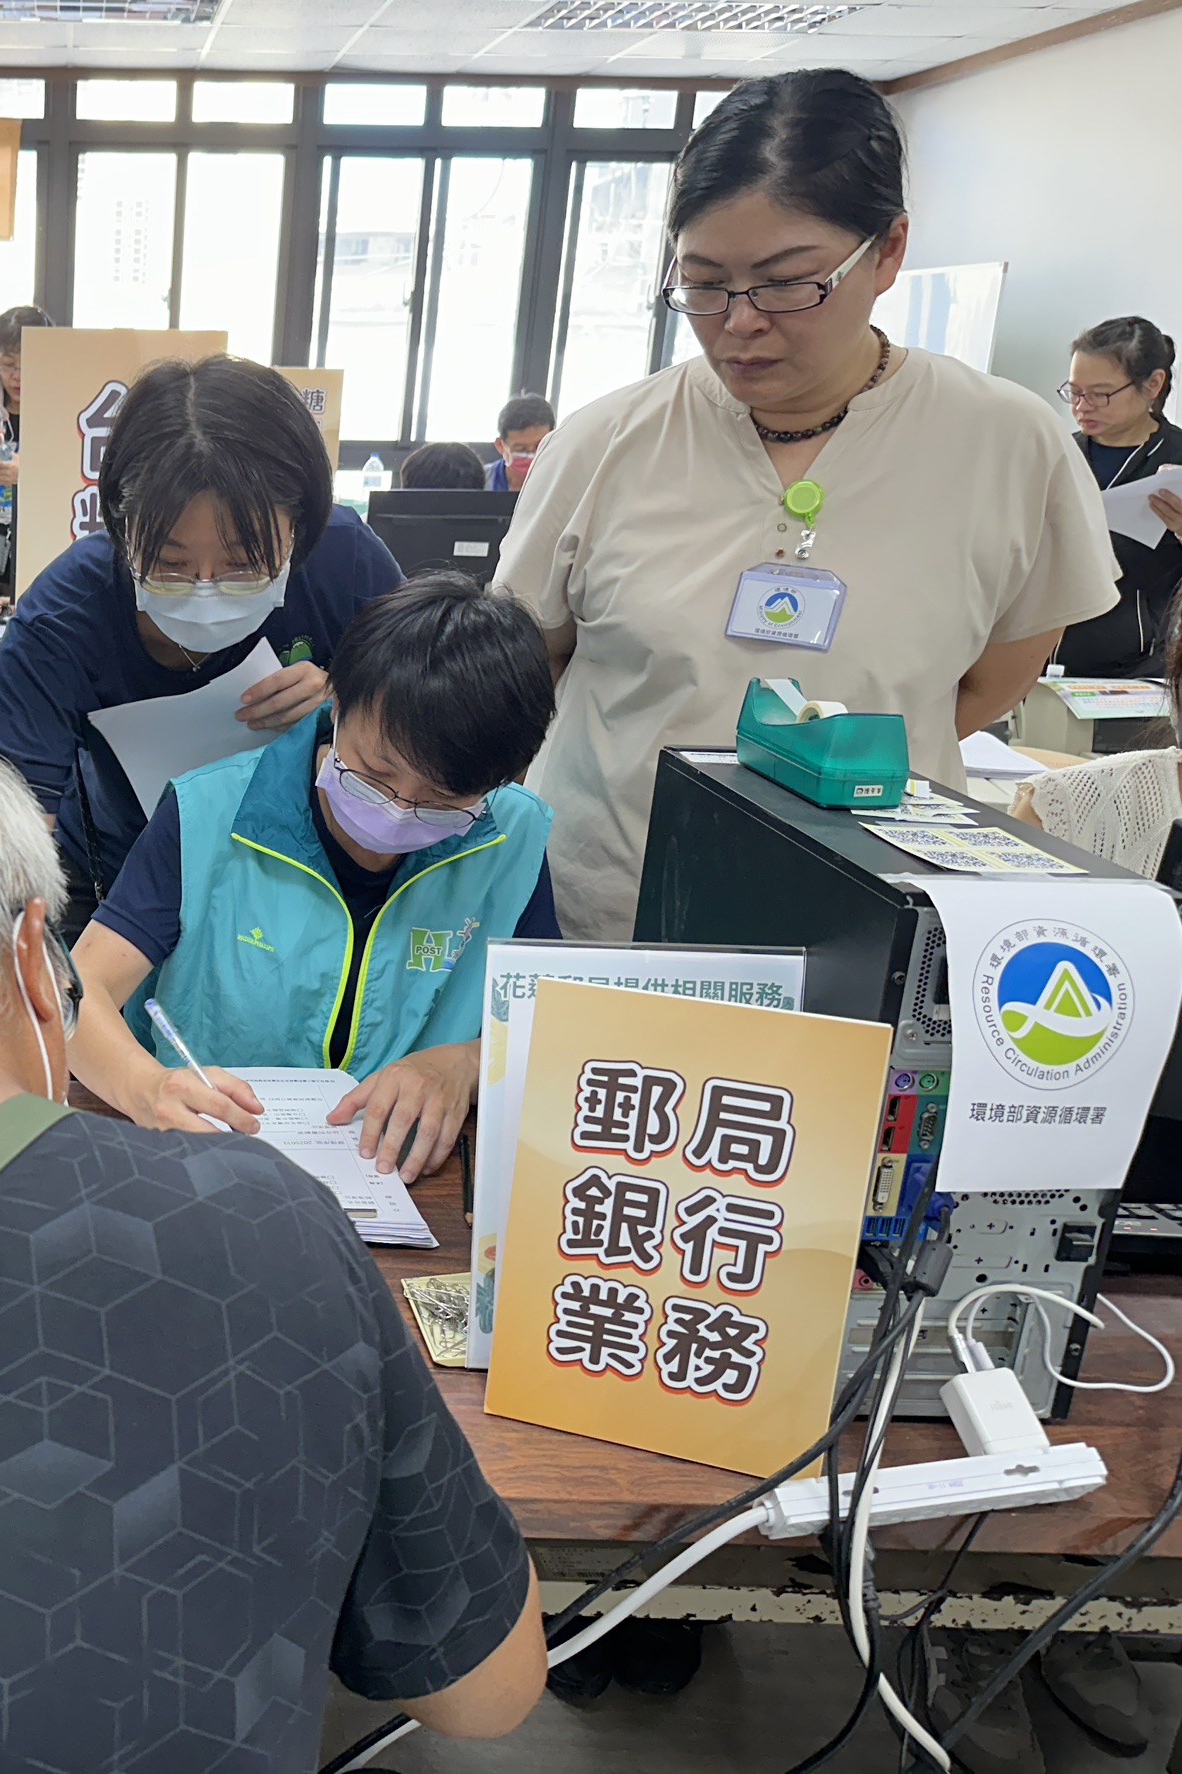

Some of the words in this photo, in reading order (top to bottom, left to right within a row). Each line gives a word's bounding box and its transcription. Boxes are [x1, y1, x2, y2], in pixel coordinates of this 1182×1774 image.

[415, 946, 443, 956] POST
[981, 974, 1005, 1047] Resource
[1004, 1046, 1069, 1081] Circulation
[1074, 982, 1128, 1076] Administration
[572, 1060, 796, 1184] 郵局
[969, 1102, 1107, 1125] 環境部資源循環署
[559, 1167, 782, 1291] 銀行
[550, 1275, 768, 1404] 業務
